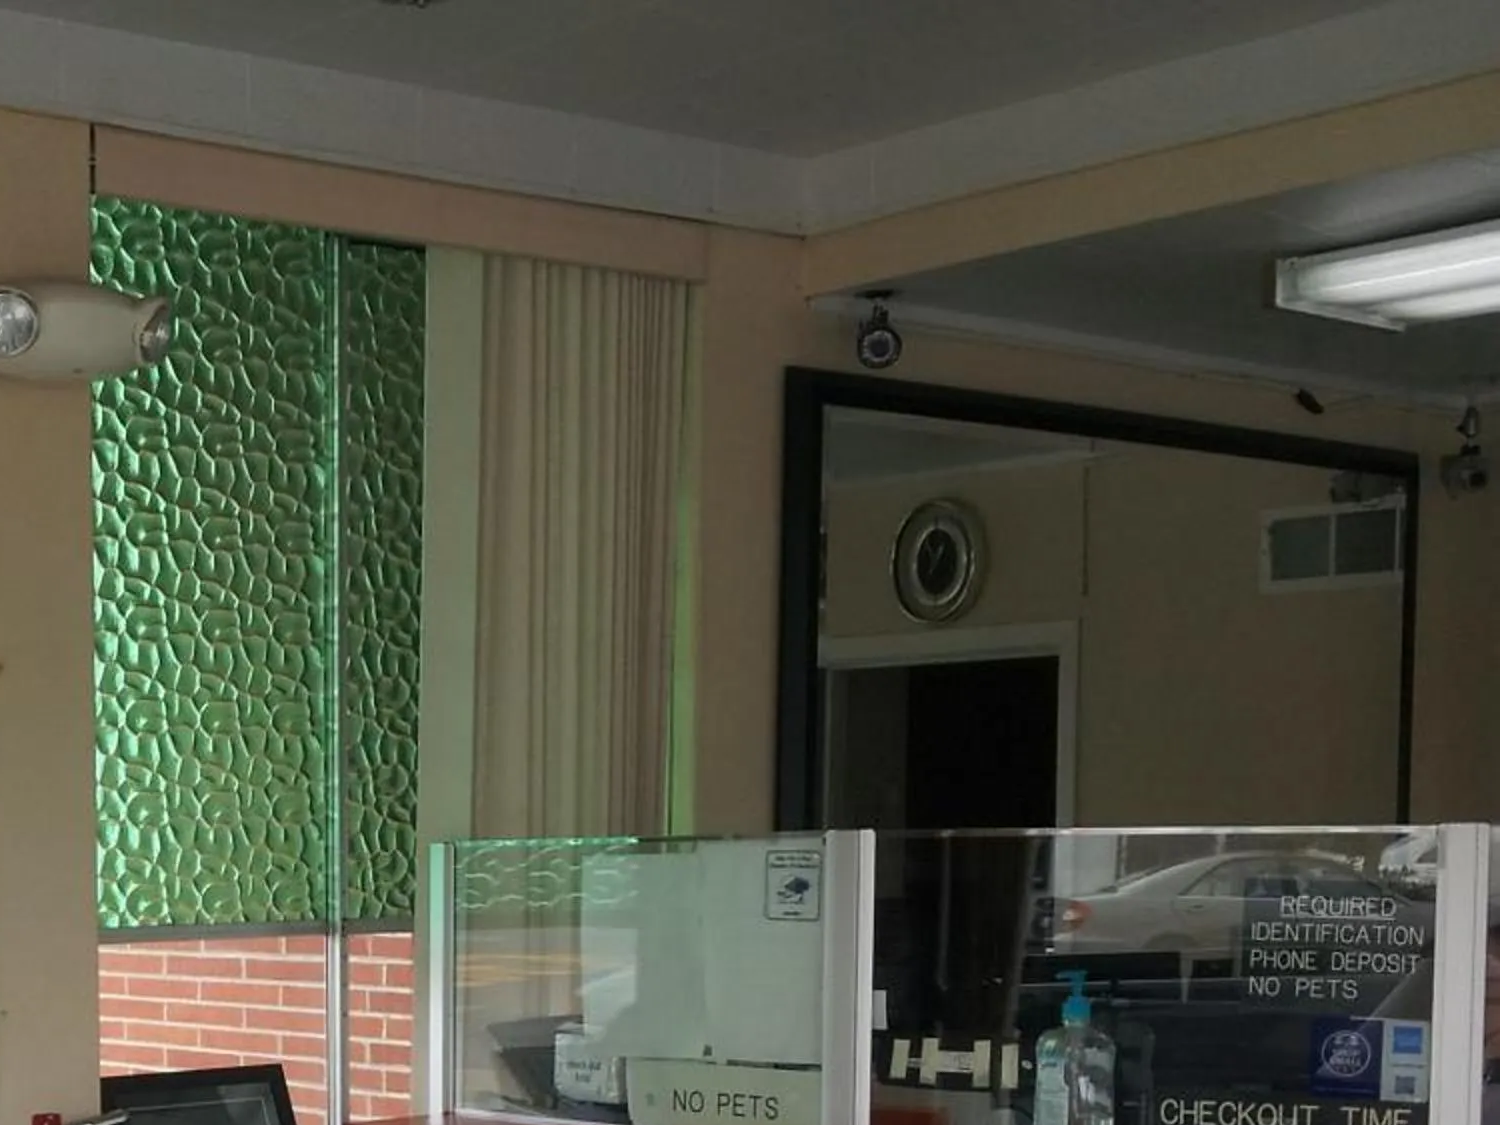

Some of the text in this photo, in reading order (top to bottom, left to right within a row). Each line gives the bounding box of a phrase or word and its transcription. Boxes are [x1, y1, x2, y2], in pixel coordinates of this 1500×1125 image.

[1280, 895, 1397, 918] REQUIRED
[1251, 921, 1425, 946] IDENTIFICATION
[1250, 950, 1421, 974] PHONE DEPOSIT
[1249, 976, 1358, 999] NO PETS
[672, 1089, 779, 1120] NO PETS
